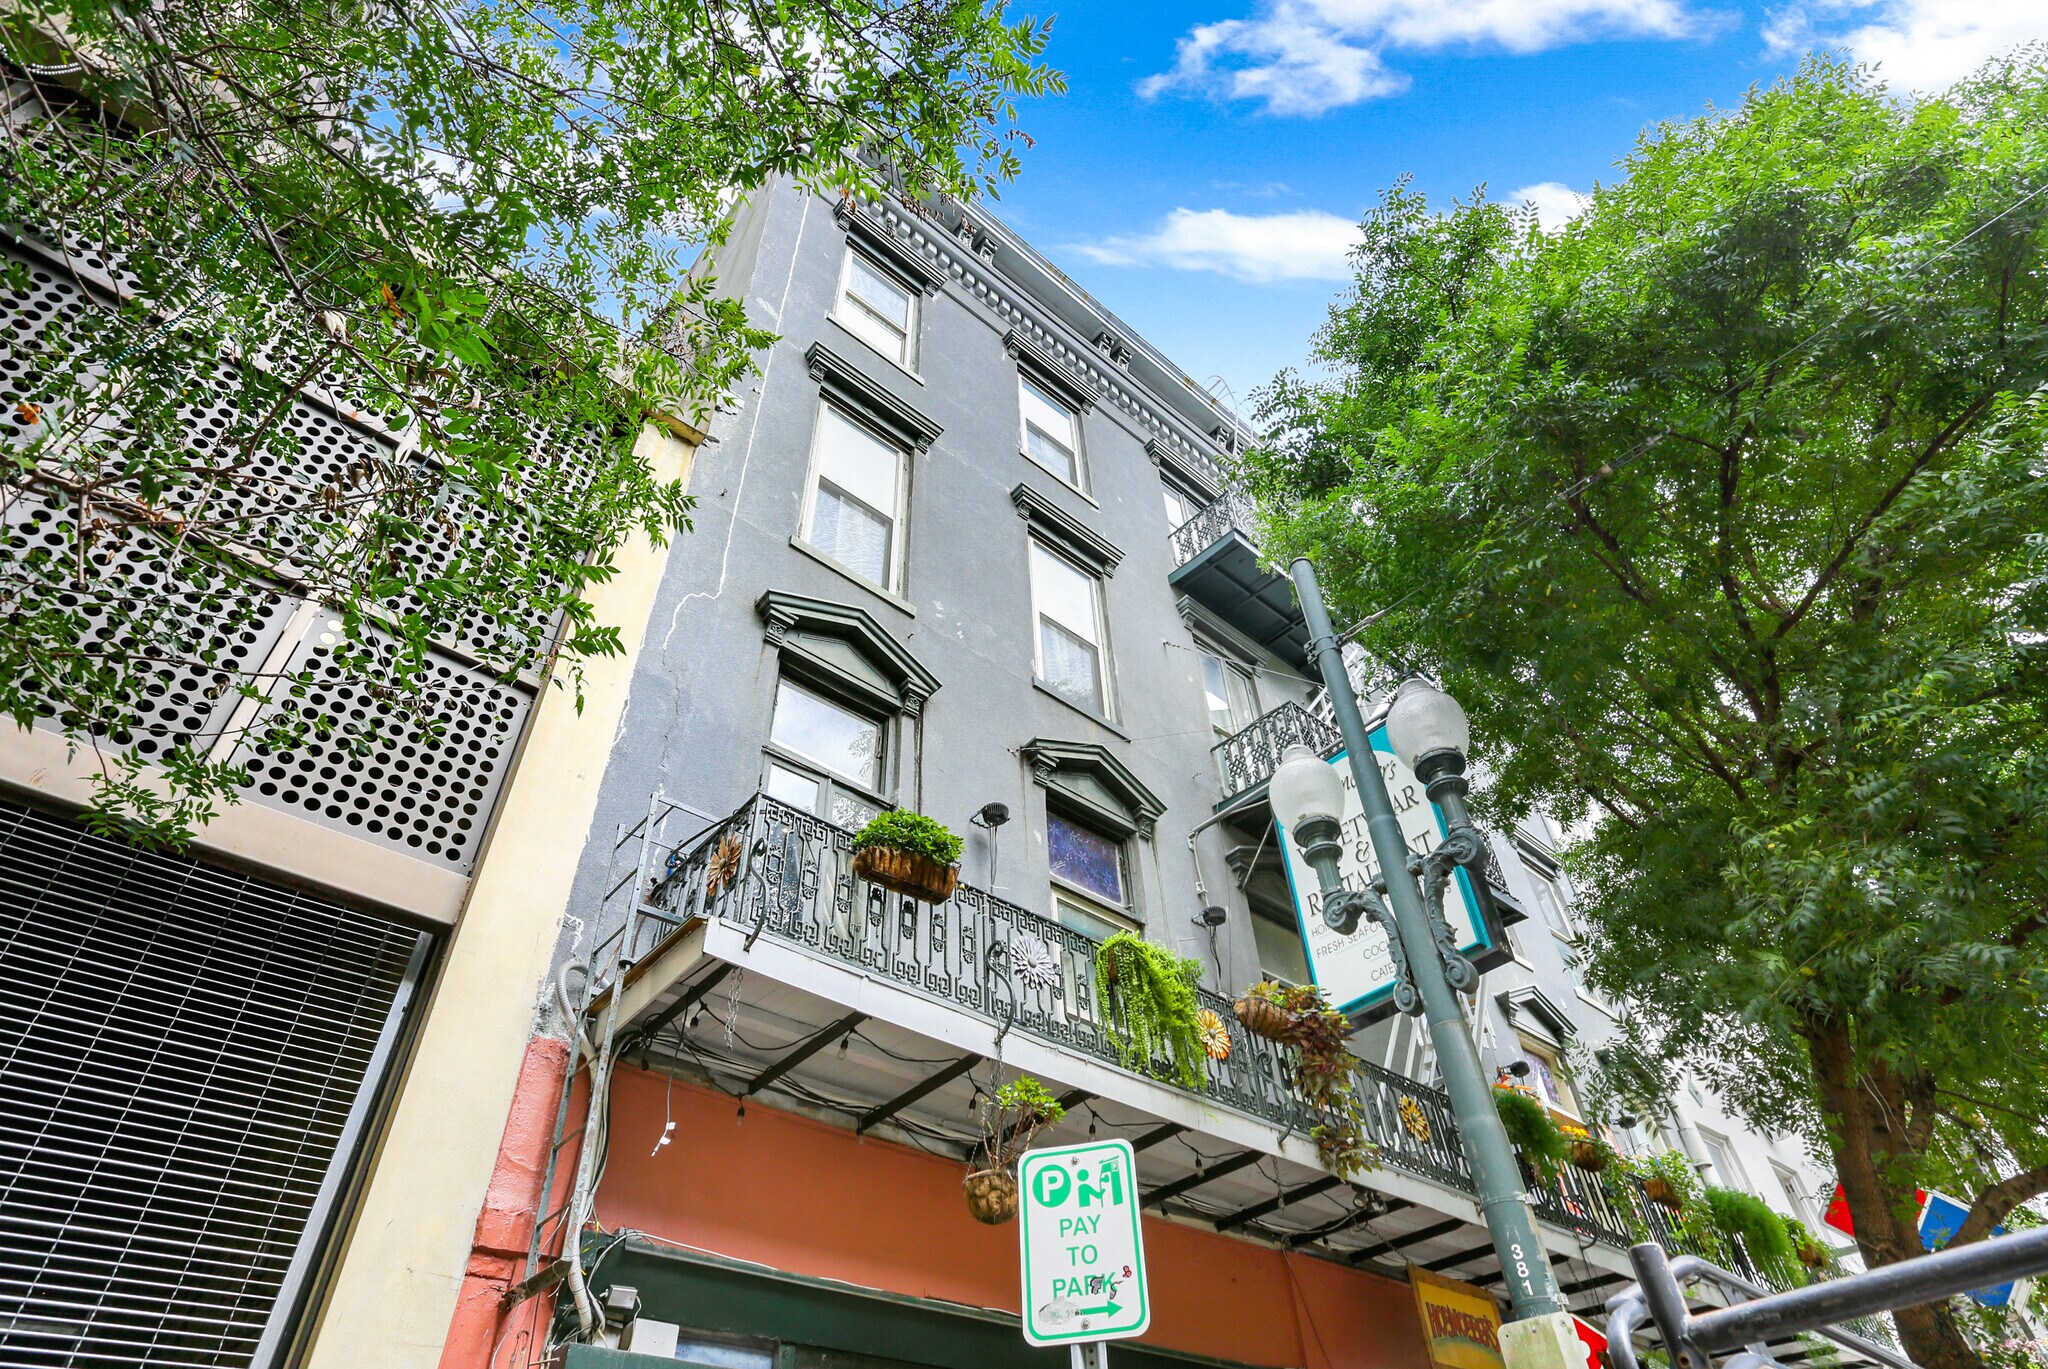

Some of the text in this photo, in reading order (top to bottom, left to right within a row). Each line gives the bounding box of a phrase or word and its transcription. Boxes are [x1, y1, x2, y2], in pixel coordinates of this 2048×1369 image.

[1355, 840, 1370, 863] &
[1316, 937, 1345, 959] FRESH
[1348, 921, 1385, 945] SEAFO
[1059, 1213, 1102, 1238] PAY
[1066, 1244, 1098, 1267] TO
[1510, 1243, 1534, 1296] 381
[1052, 1271, 1119, 1299] PARK
